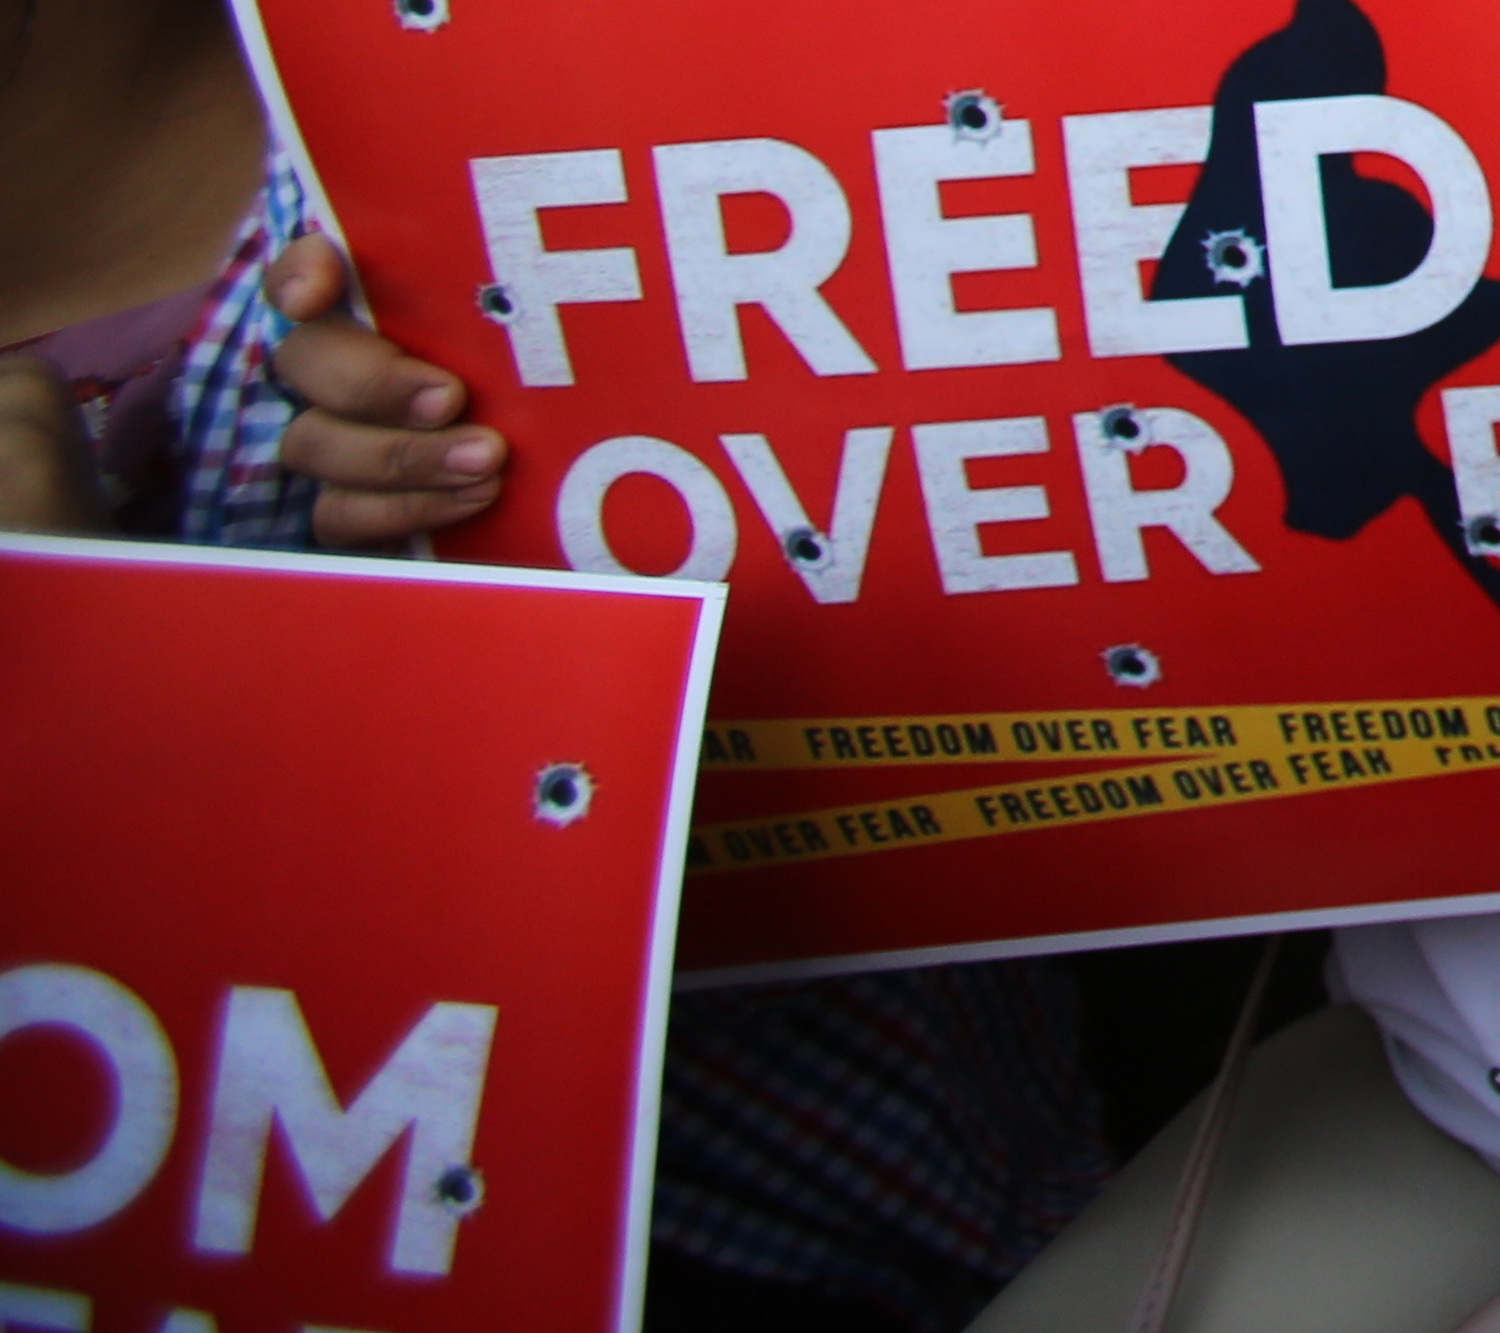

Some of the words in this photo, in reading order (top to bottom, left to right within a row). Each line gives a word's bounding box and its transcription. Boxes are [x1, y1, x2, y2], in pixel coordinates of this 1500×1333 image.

[555, 406, 1262, 604] OVER
[805, 721, 1001, 762] FREEDOM
[1011, 717, 1121, 755] OVER
[1130, 714, 1239, 751] FEAR
[1276, 707, 1470, 745] FREEDOM
[722, 819, 831, 864] OVER
[834, 803, 943, 849] FEAR
[973, 773, 1164, 830] FREEDOM
[1172, 757, 1280, 802] OVER
[1287, 744, 1394, 786] FEAR
